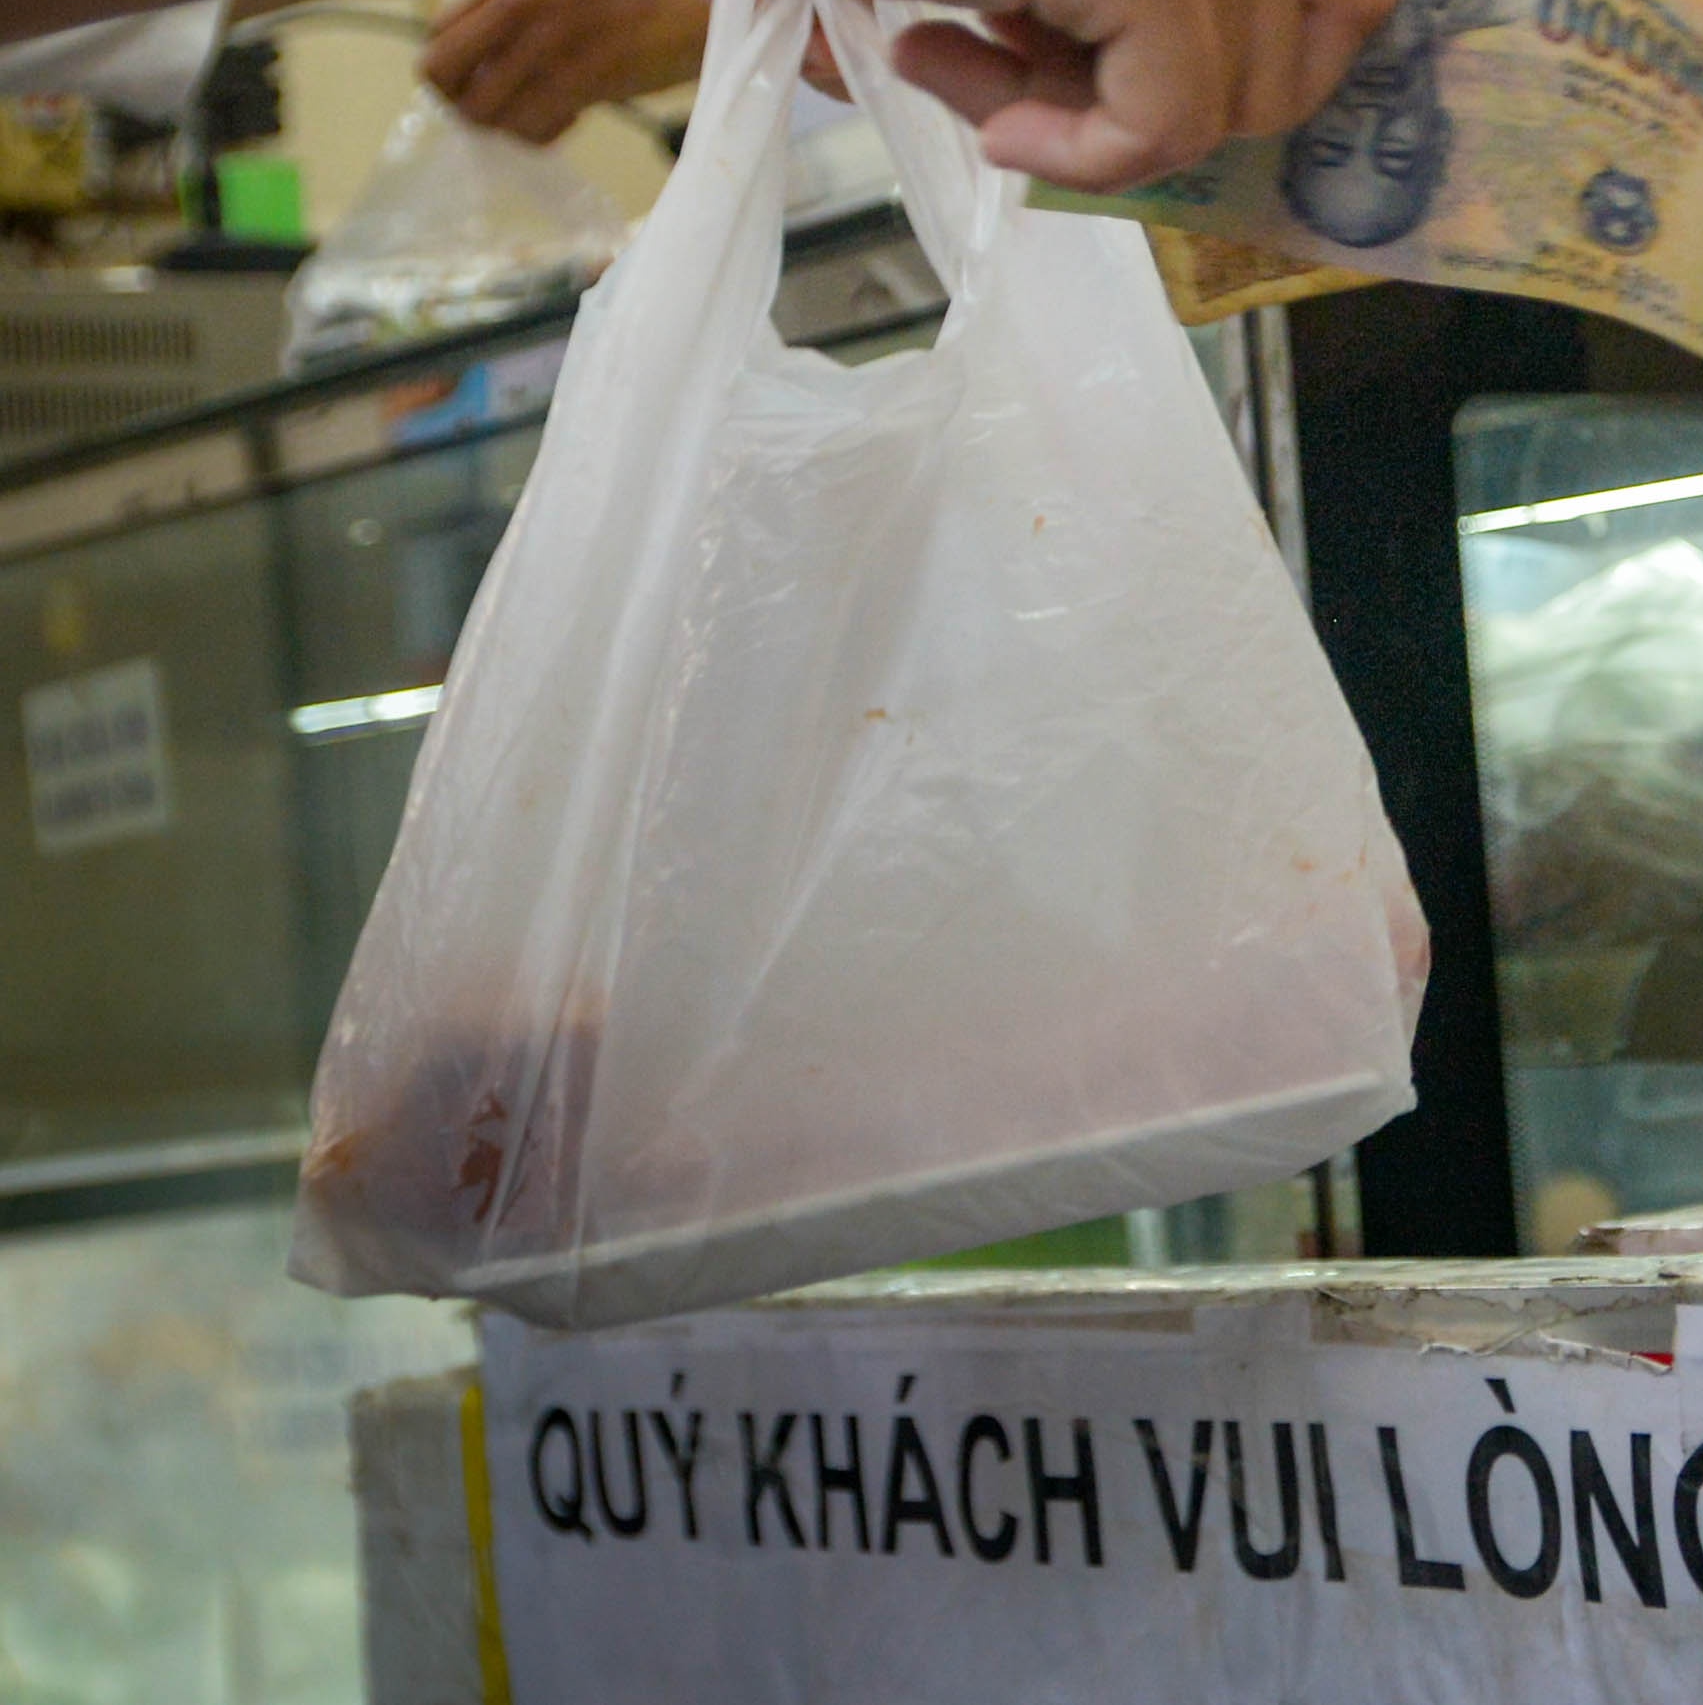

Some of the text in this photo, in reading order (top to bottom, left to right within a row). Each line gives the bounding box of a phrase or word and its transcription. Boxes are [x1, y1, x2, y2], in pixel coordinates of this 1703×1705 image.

[528, 1371, 704, 1542] QUÝ
[738, 1374, 1104, 1567] KHÁCH
[1132, 1418, 1346, 1582] VUI
